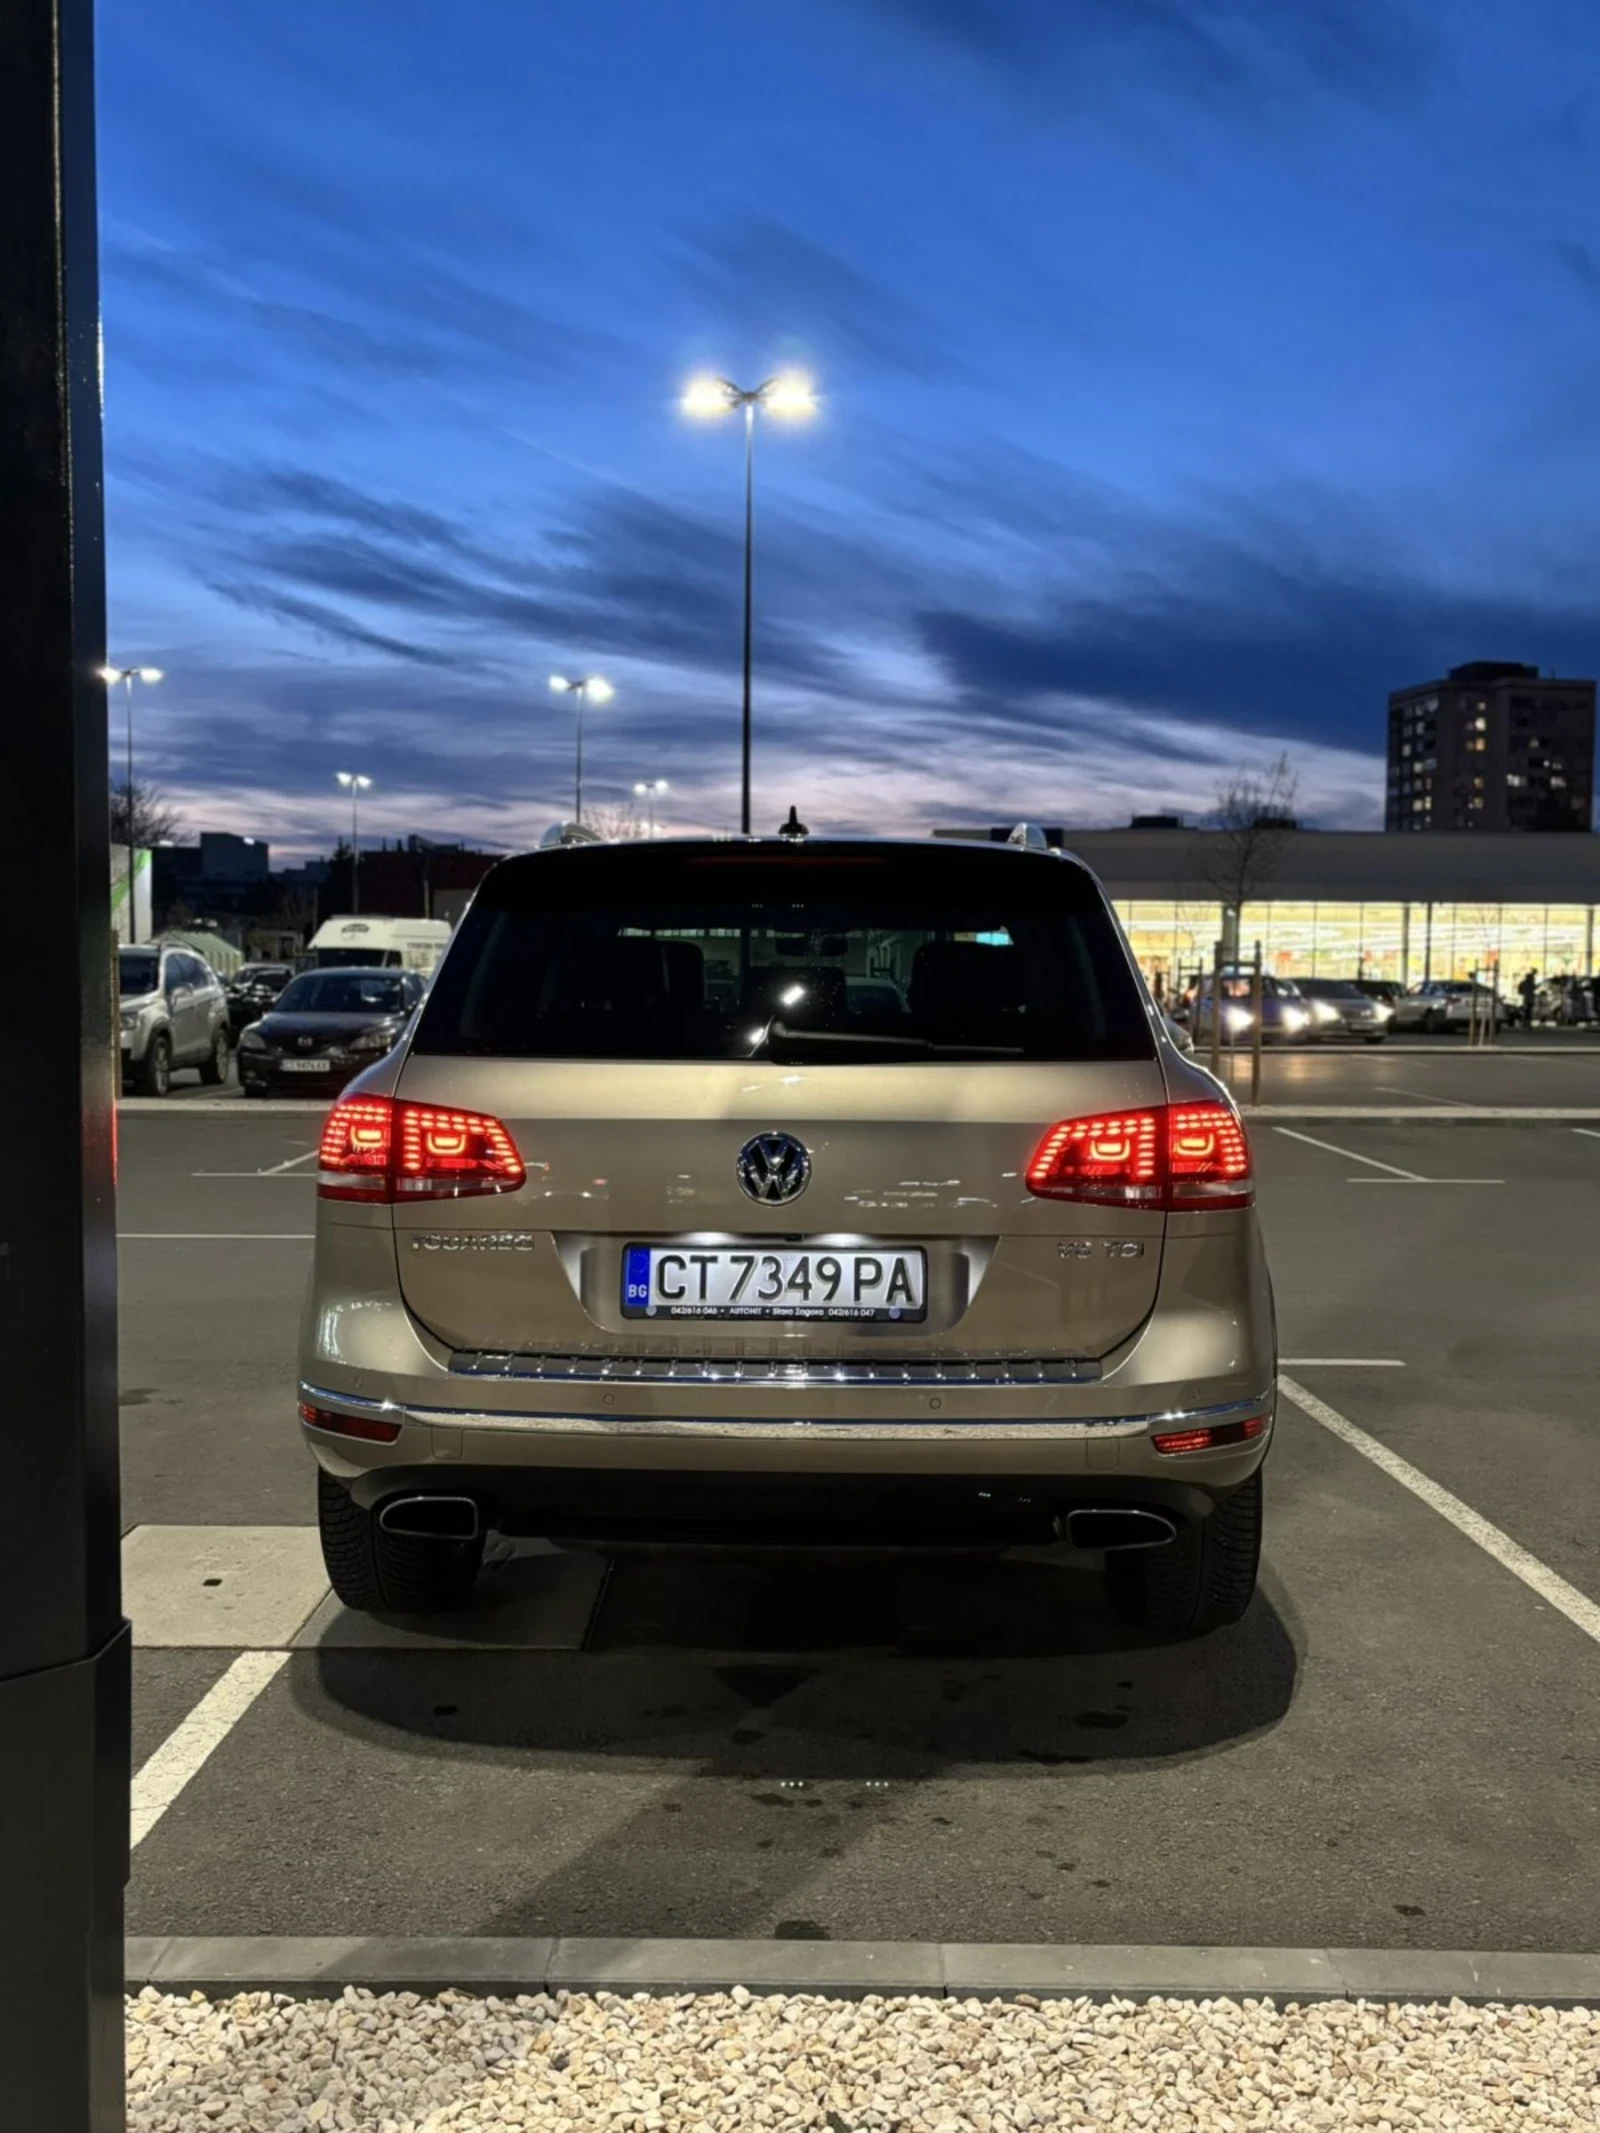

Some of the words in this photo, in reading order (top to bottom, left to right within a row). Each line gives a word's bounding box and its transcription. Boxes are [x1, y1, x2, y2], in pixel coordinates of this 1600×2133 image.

[727, 1255, 842, 1301] 7349
[628, 1284, 648, 1298] BG
[772, 1307, 795, 1316] Stara
[795, 1307, 825, 1318] Zagora
